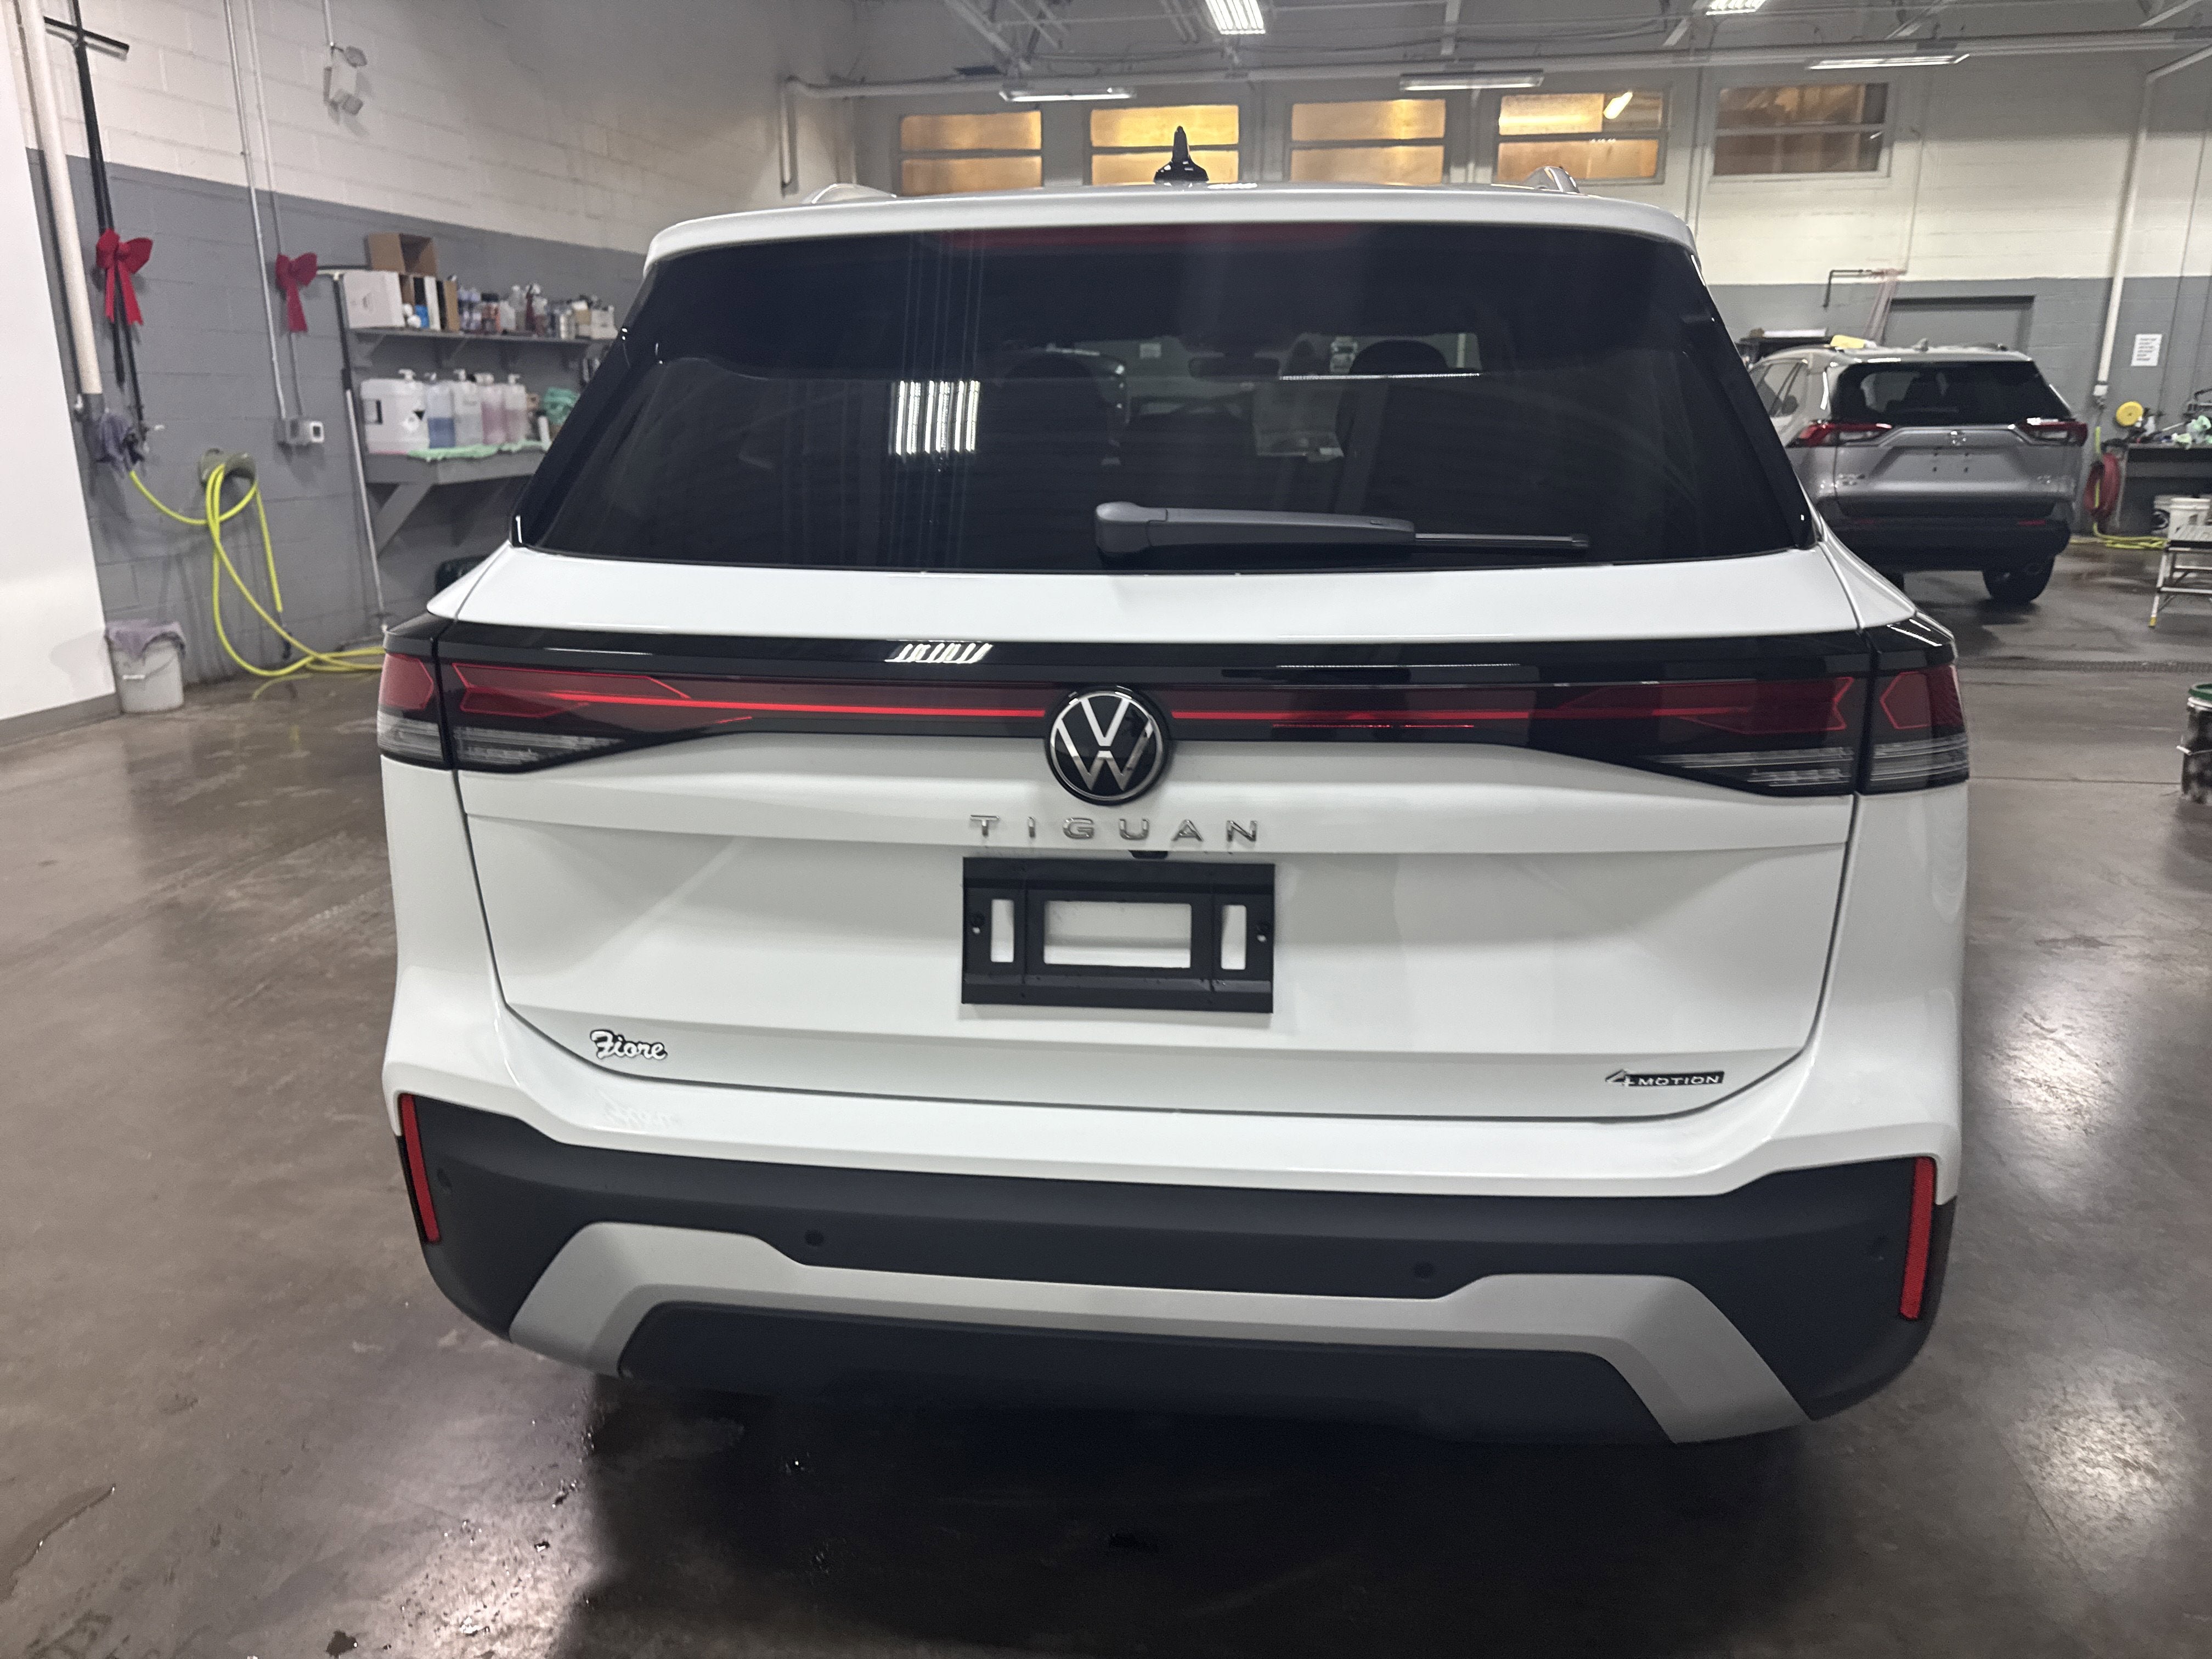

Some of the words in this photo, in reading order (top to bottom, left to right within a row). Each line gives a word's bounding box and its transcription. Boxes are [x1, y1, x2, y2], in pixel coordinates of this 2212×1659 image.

[1053, 695, 1158, 797] VW
[970, 815, 1258, 842] TIGUAN
[590, 1029, 668, 1060] Fiore
[1605, 1068, 1720, 1087] 4MOTION
